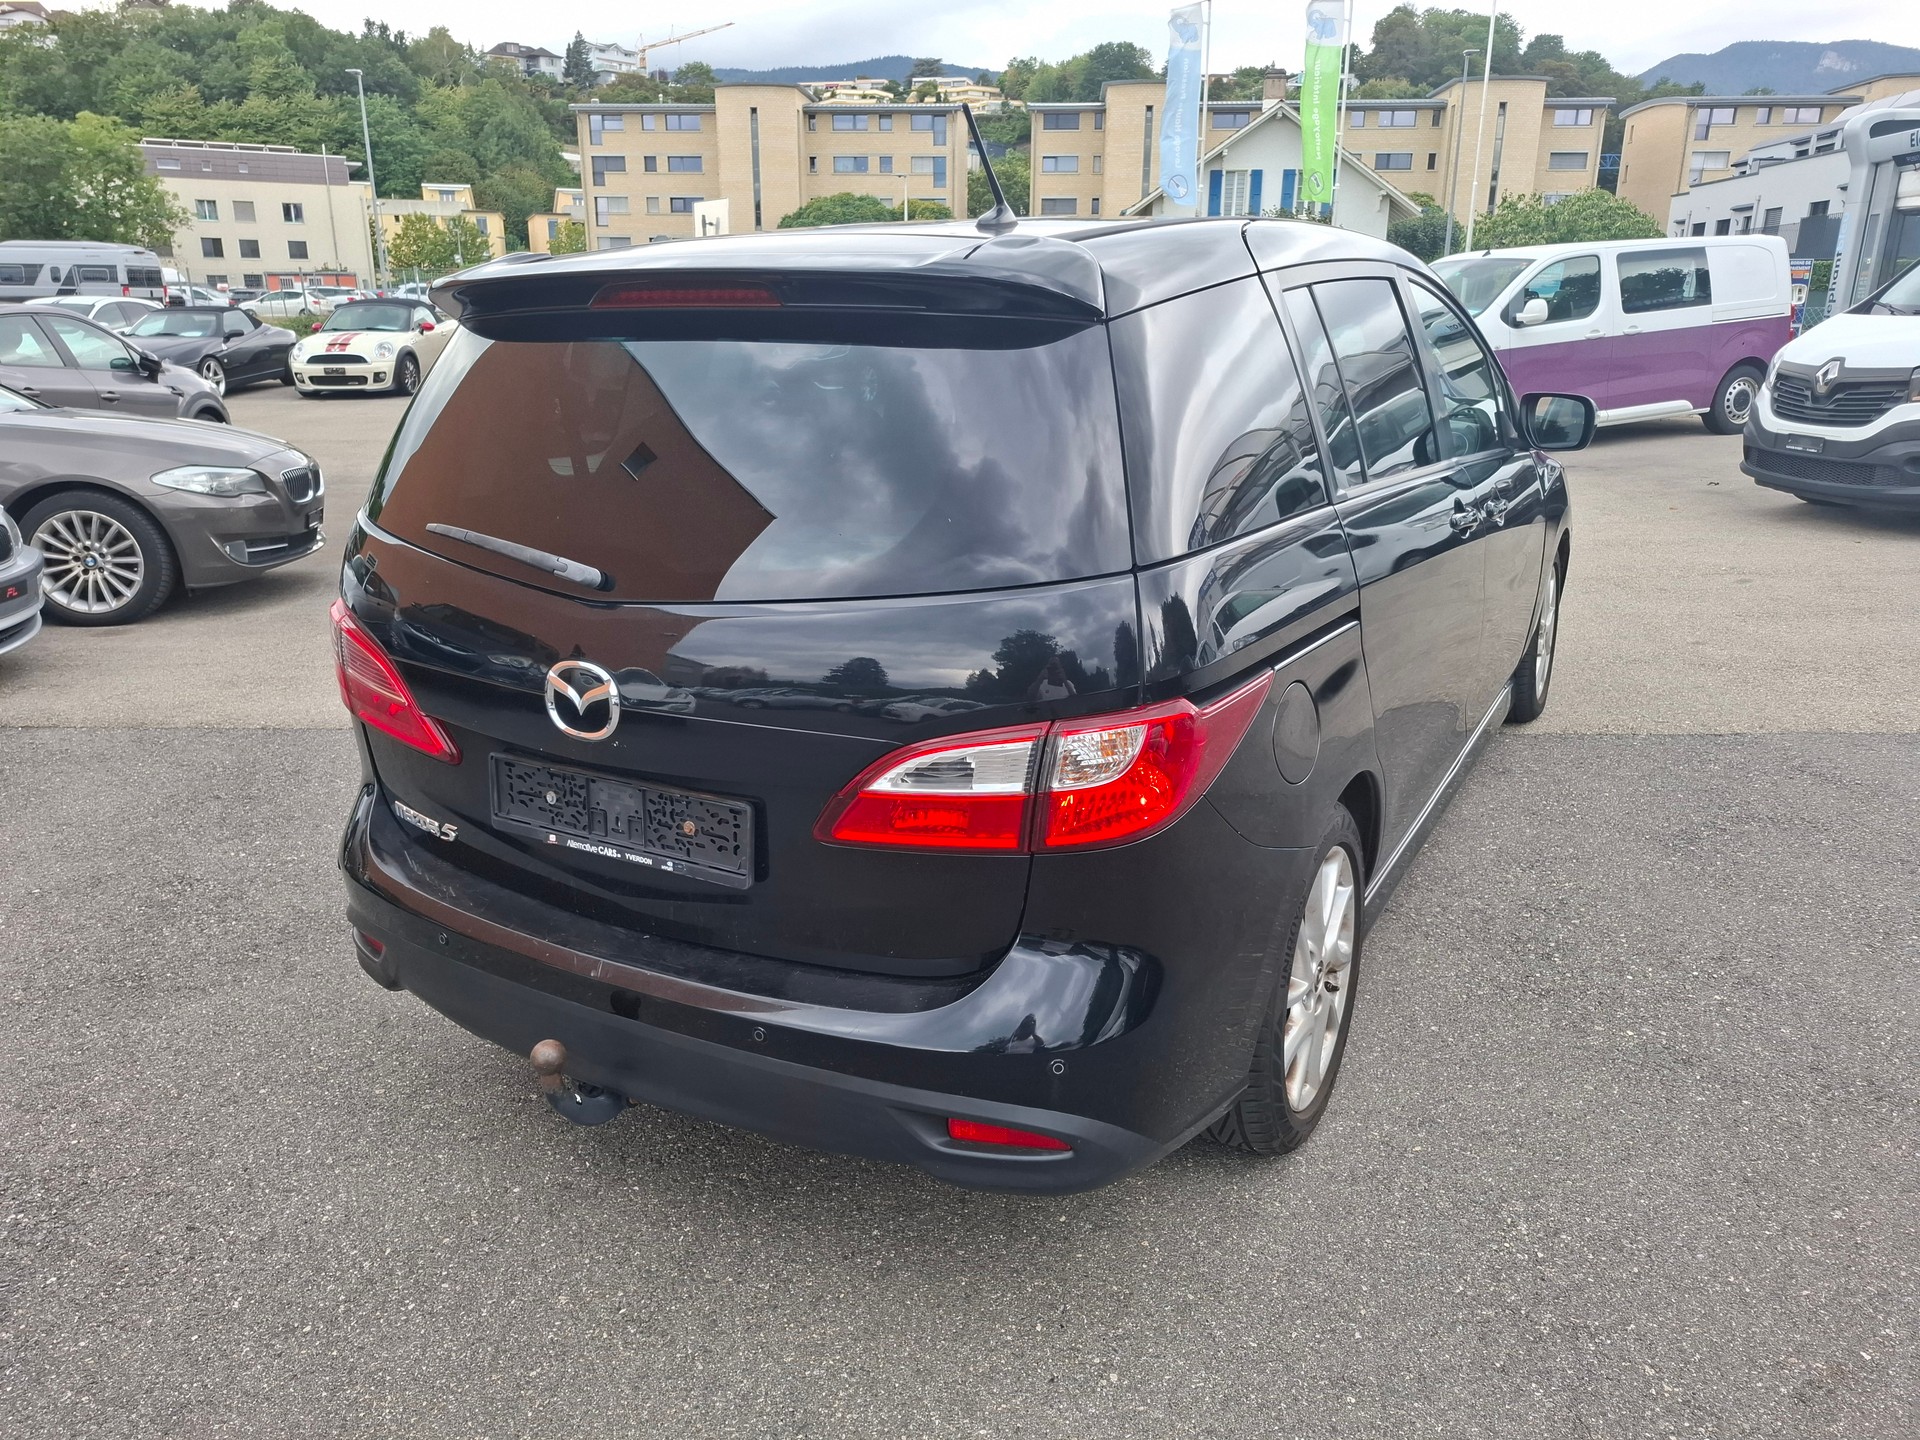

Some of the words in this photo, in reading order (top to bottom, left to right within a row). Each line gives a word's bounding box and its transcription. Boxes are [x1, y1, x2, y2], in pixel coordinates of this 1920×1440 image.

[566, 839, 598, 853] Alternative
[598, 846, 617, 858] CARS
[625, 852, 652, 865] YVERDON
